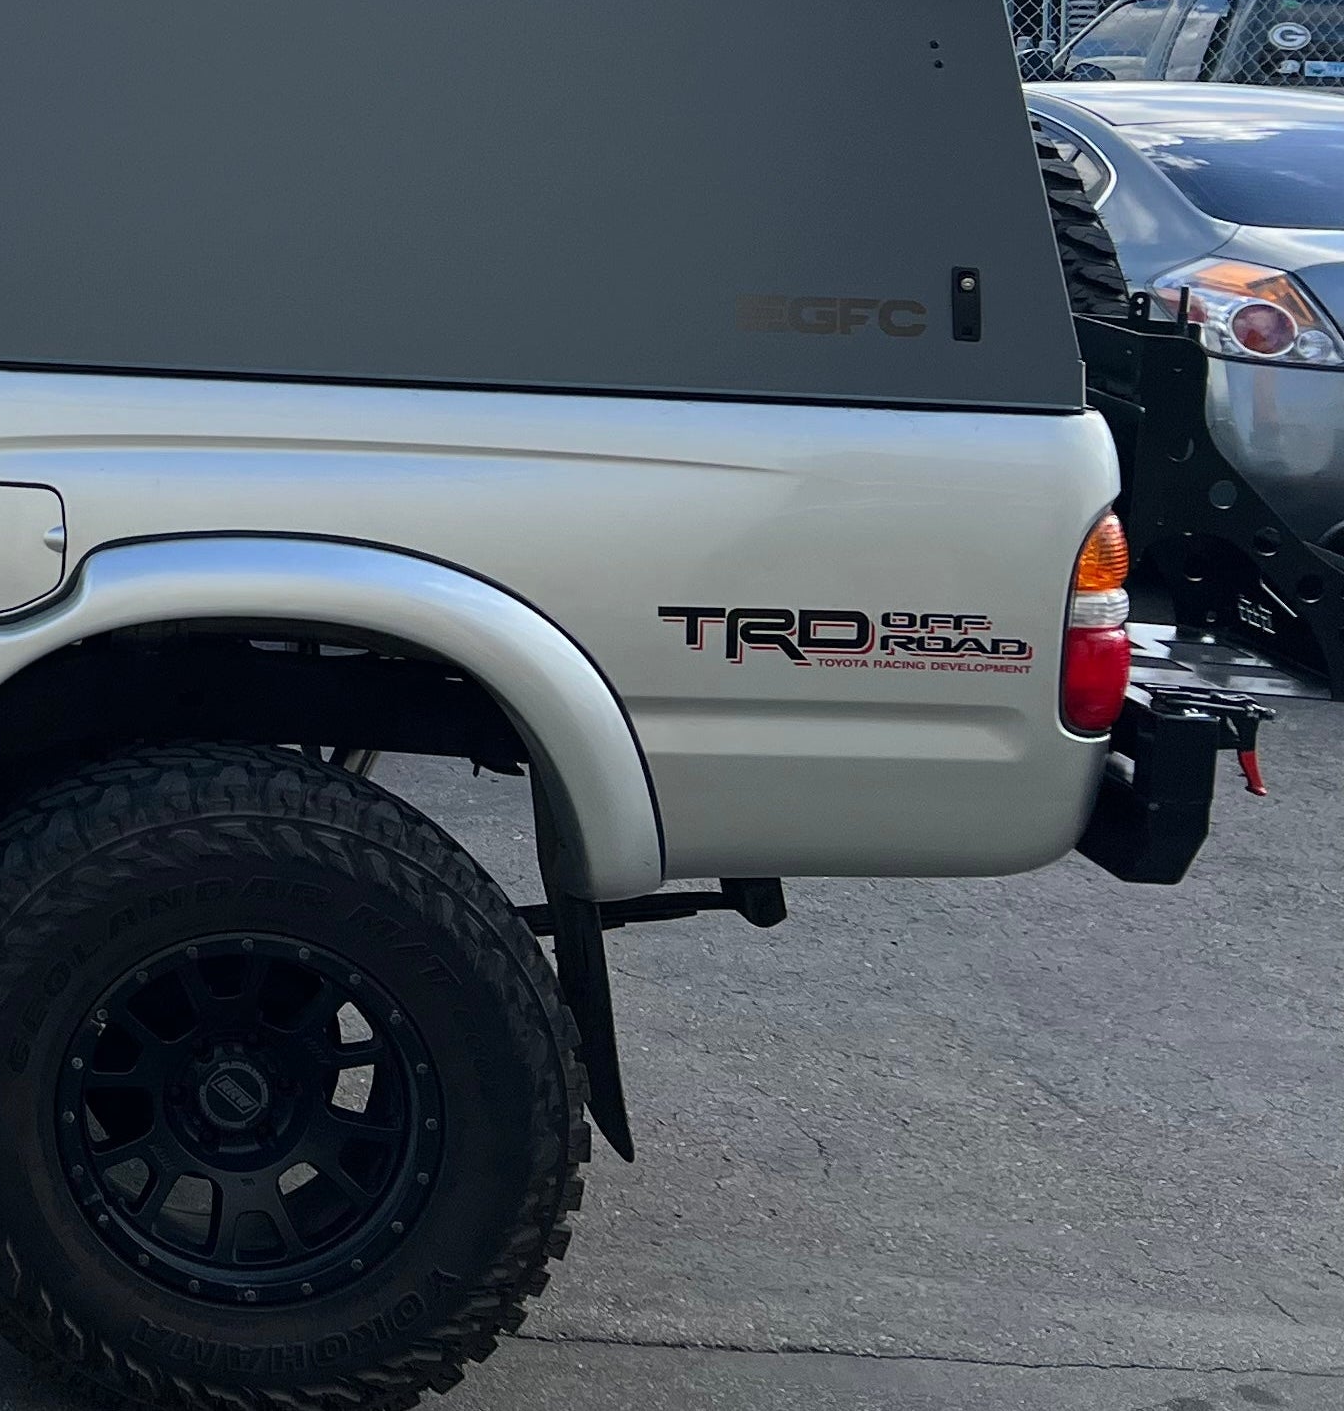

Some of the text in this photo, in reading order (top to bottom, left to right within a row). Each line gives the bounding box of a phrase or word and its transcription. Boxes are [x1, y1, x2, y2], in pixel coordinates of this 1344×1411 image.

[789, 295, 927, 337] GFC
[658, 606, 993, 665] TRD OFF
[880, 634, 1033, 660] ROAD
[816, 657, 1032, 674] TOYOTA RACING DEVELOPMENT
[131, 1265, 463, 1376] YOKOHAMA
